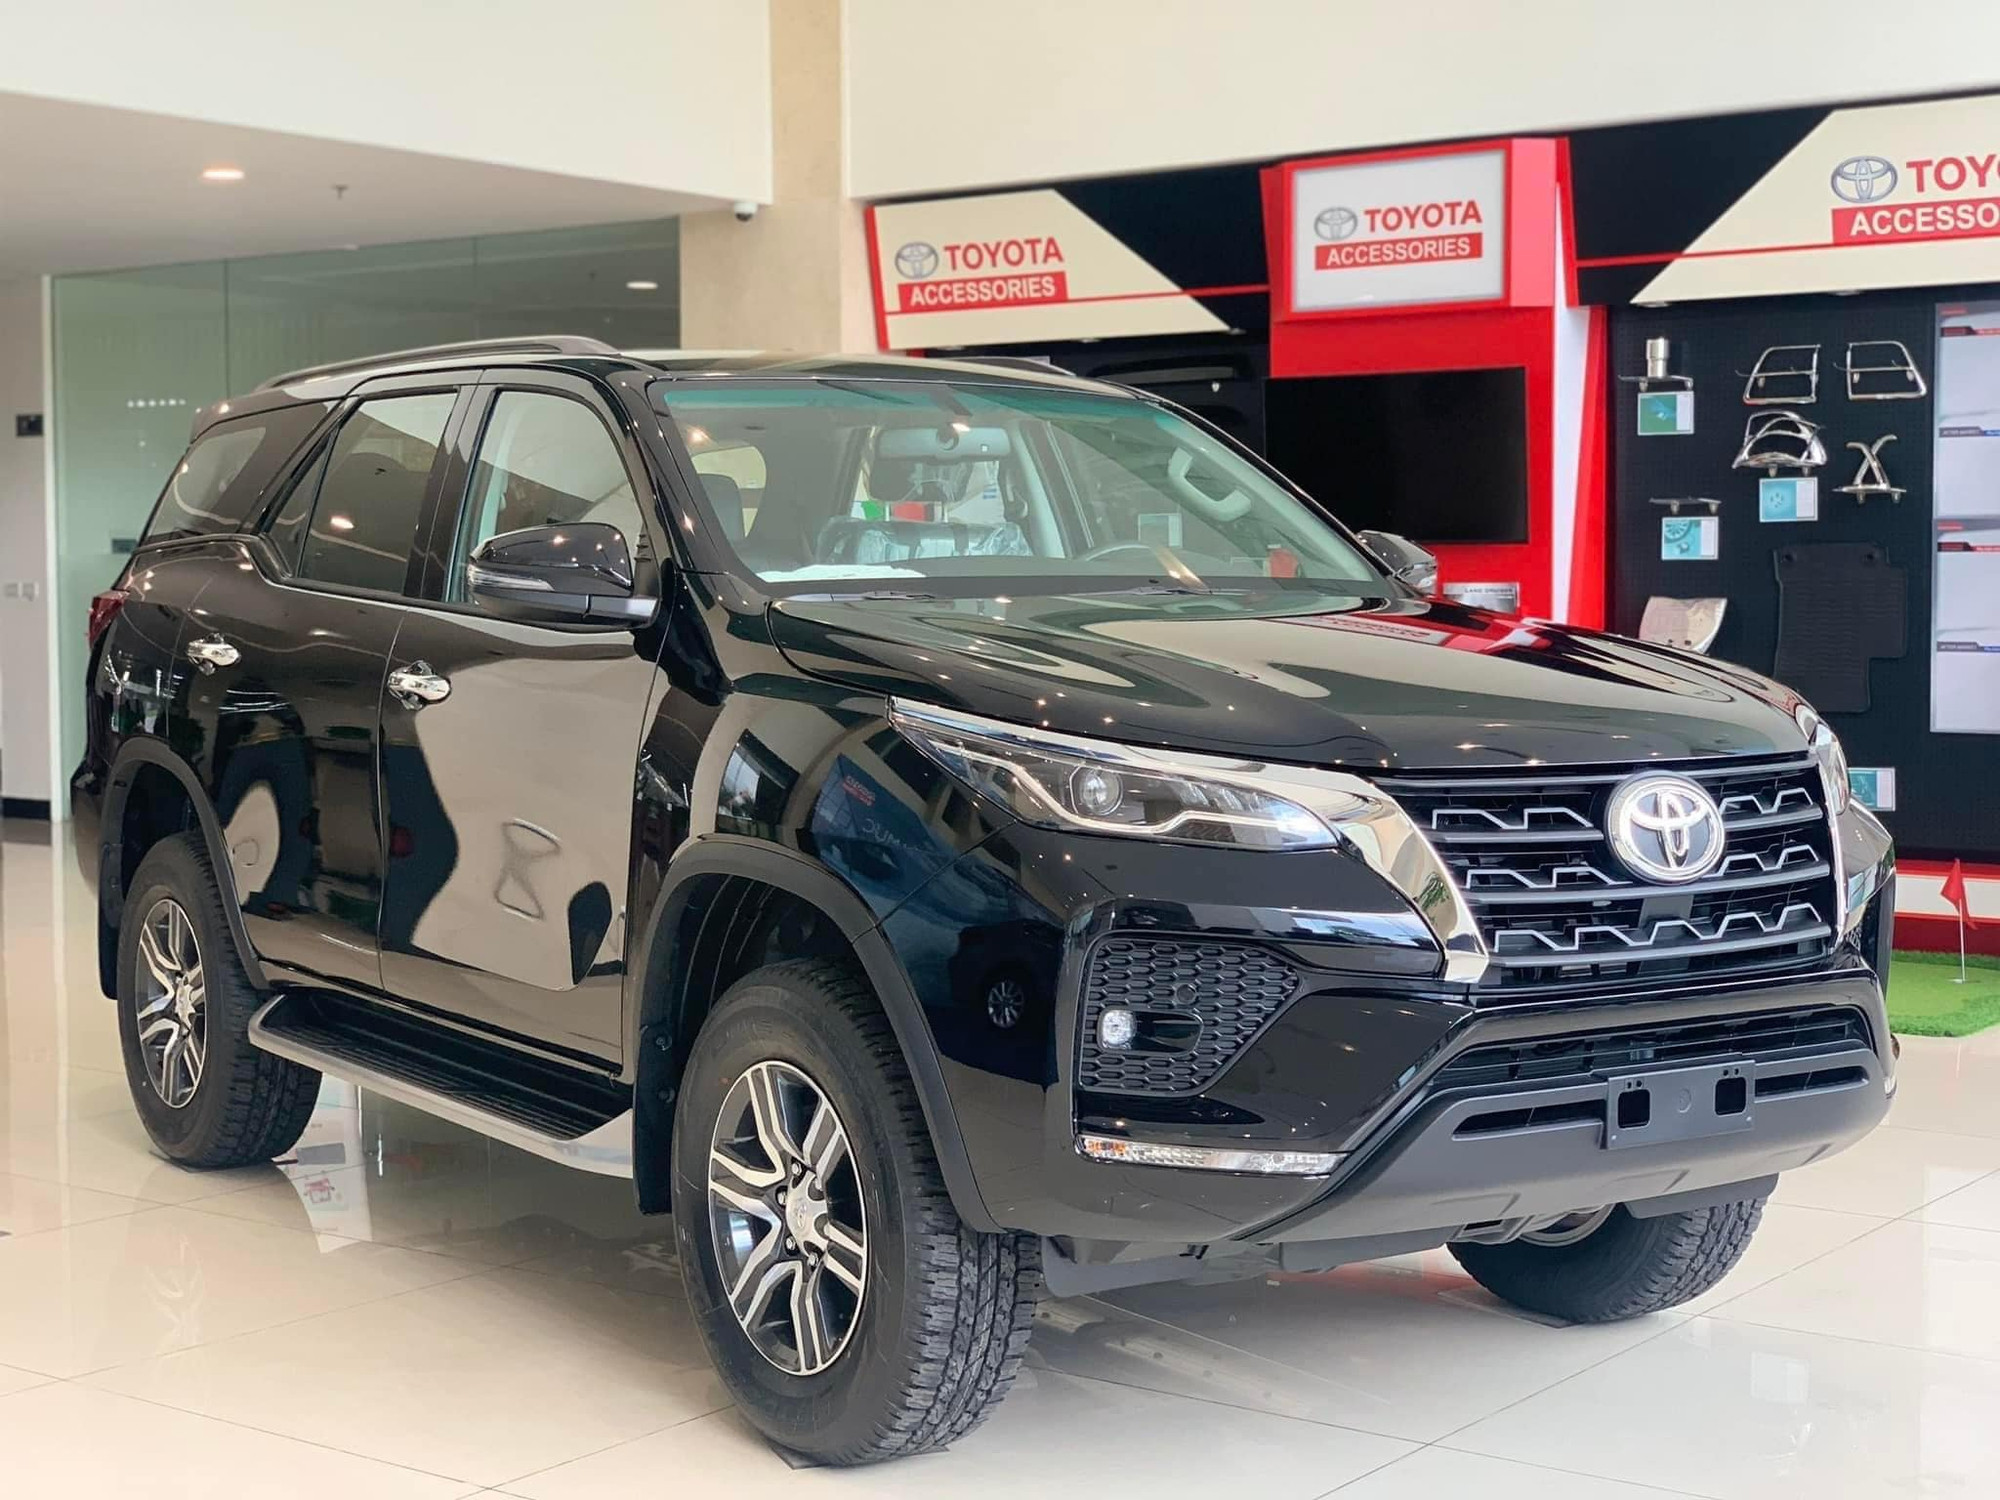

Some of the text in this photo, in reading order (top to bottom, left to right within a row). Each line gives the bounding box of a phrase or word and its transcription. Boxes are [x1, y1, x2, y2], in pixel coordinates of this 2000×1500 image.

[1905, 154, 2000, 193] TOY
[1364, 200, 1482, 232] TOYOTA
[944, 237, 1064, 271] TOYOTA
[1326, 237, 1470, 266] ACCESSORIES
[910, 276, 1056, 307] ACCESSORIES
